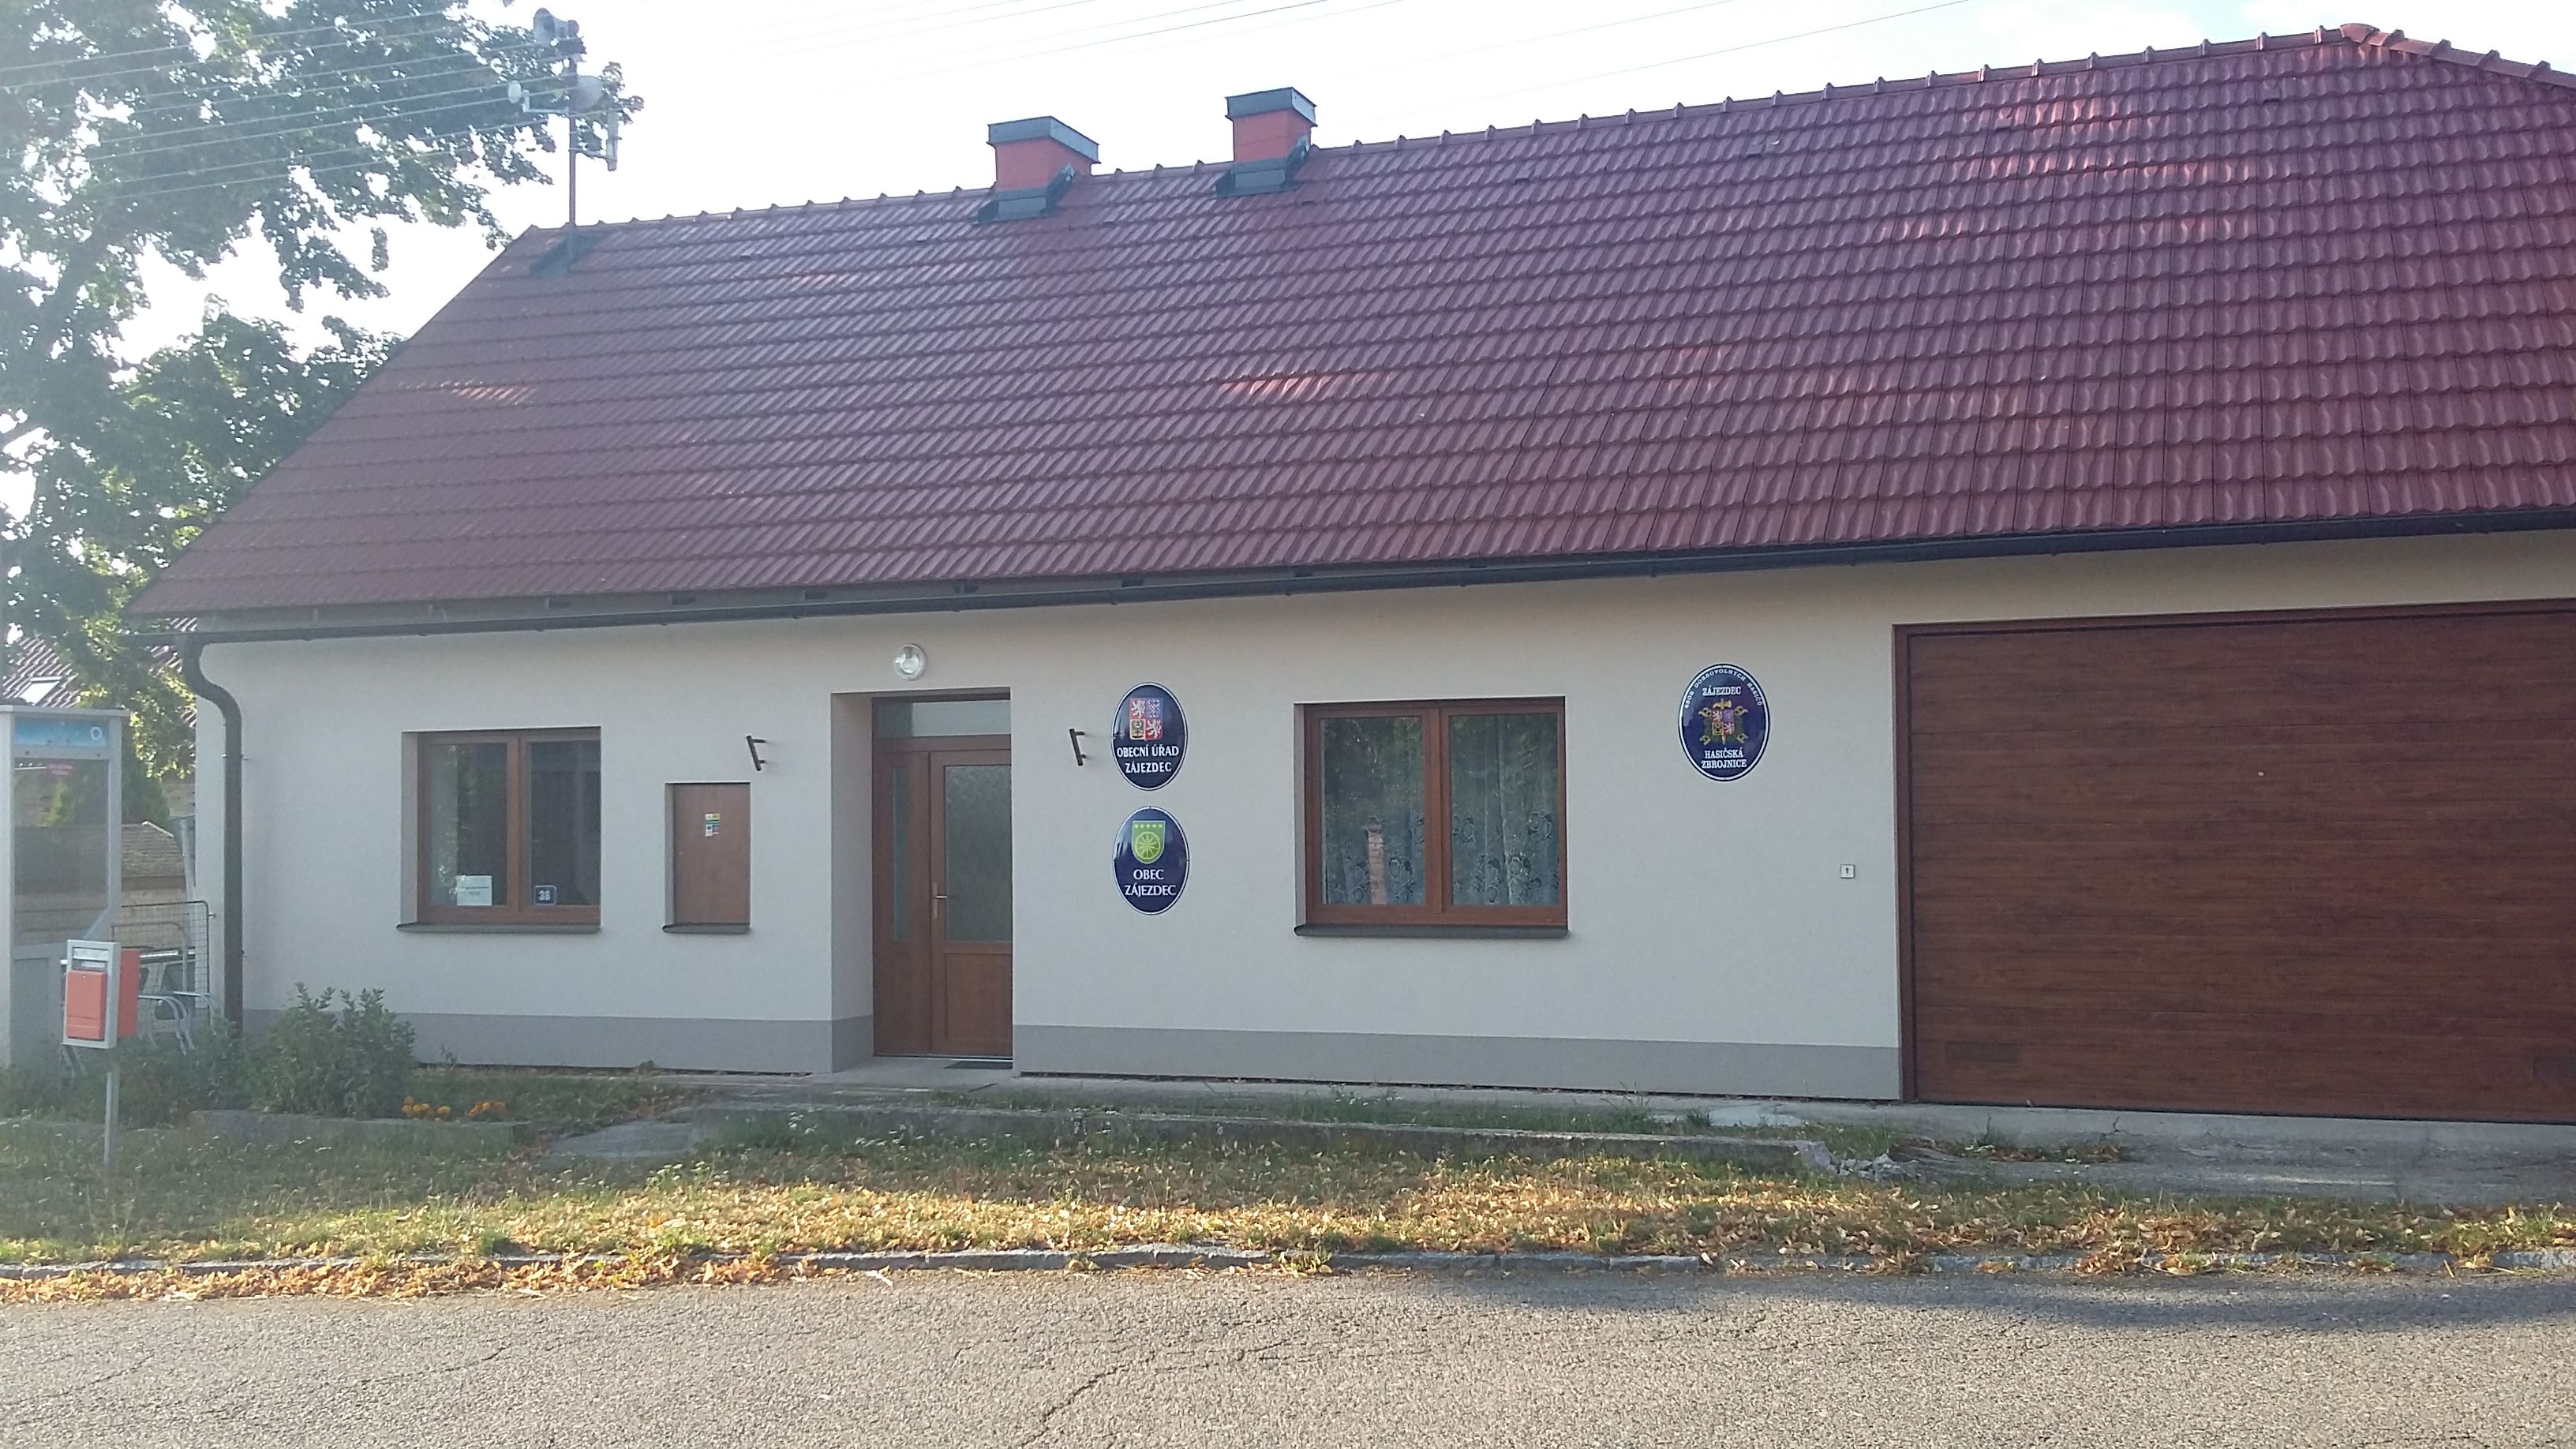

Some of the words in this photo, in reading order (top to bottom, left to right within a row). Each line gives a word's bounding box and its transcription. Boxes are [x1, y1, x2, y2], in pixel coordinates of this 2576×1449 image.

[1702, 684, 1742, 696] ZÁJEZDEC
[1117, 744, 1149, 758] OBECNÍ
[1151, 743, 1179, 757] ÚŘAD
[1704, 747, 1744, 759] HASIČSKÁ
[1125, 759, 1172, 773] ZÁJEZDEC
[1701, 758, 1747, 769] ZBROJNICE
[1133, 869, 1164, 881] OBEC
[1124, 882, 1177, 897] ZÁJEZDEC
